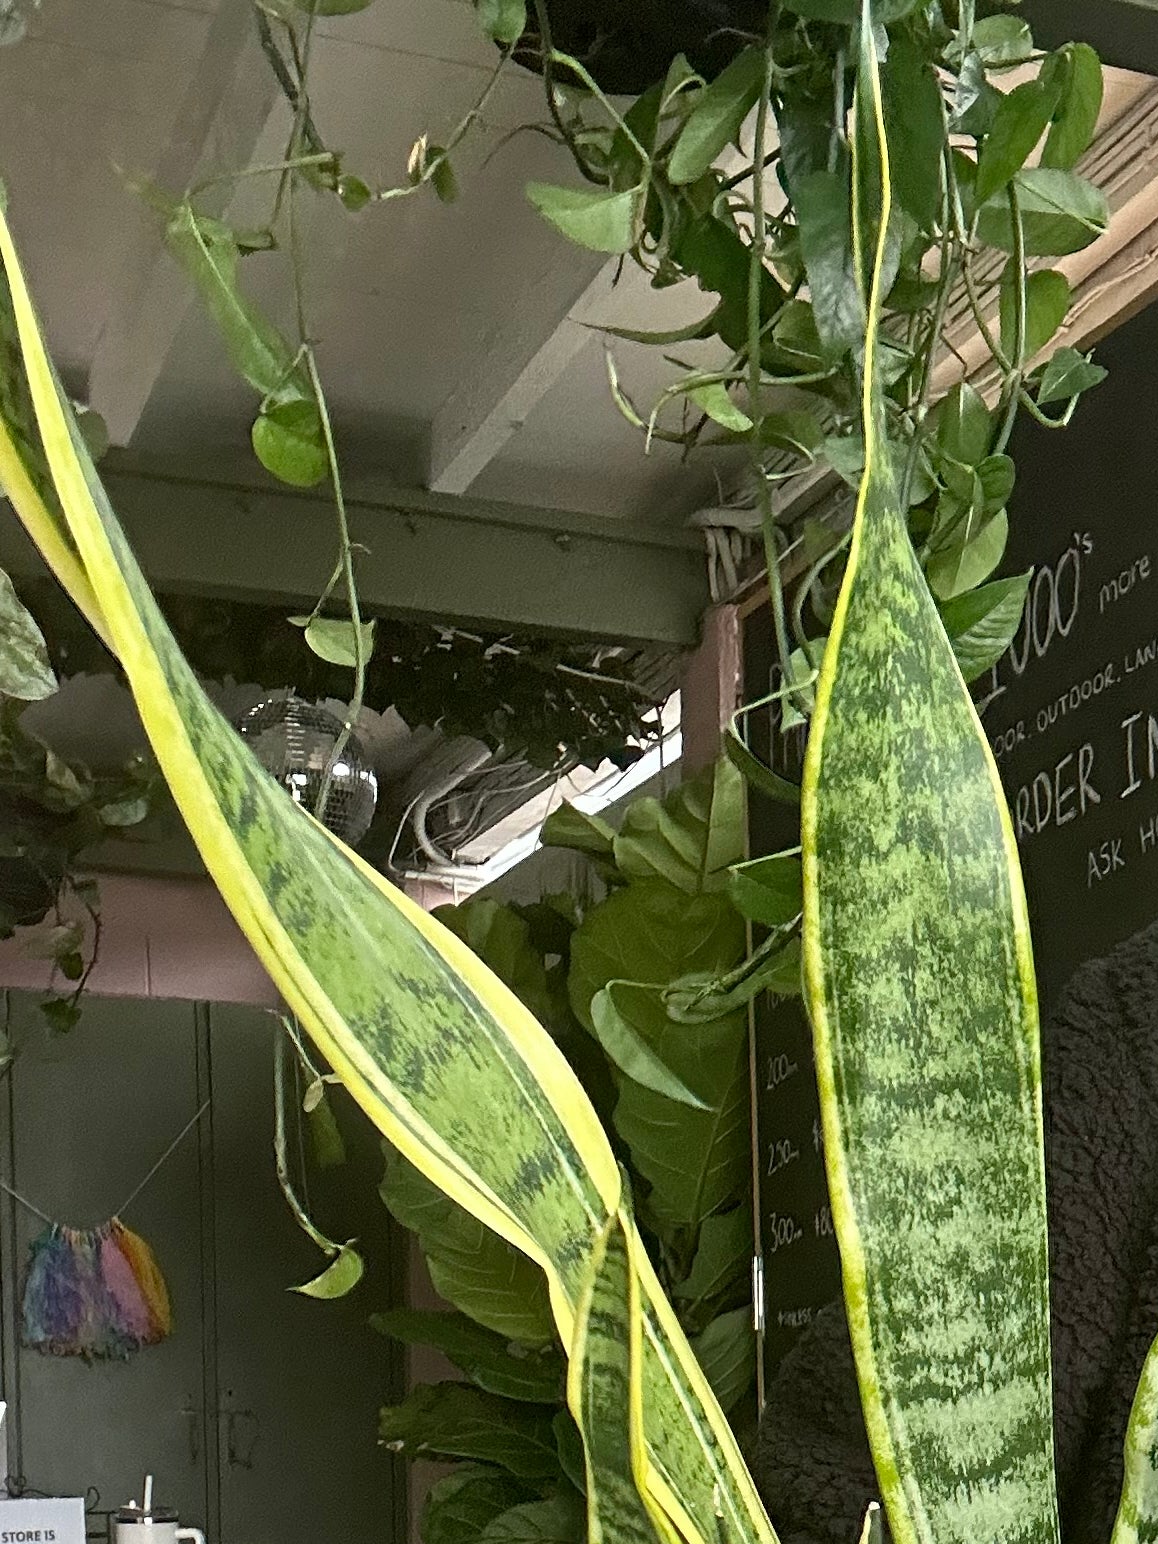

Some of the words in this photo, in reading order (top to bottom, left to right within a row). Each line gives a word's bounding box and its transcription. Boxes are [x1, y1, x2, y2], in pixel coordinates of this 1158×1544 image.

[1100, 555, 1151, 614] more
[1013, 743, 1101, 840] RDER
[1087, 838, 1126, 888] ASK
[1, 1530, 41, 1544] STORE
[44, 1529, 56, 1542] IS
